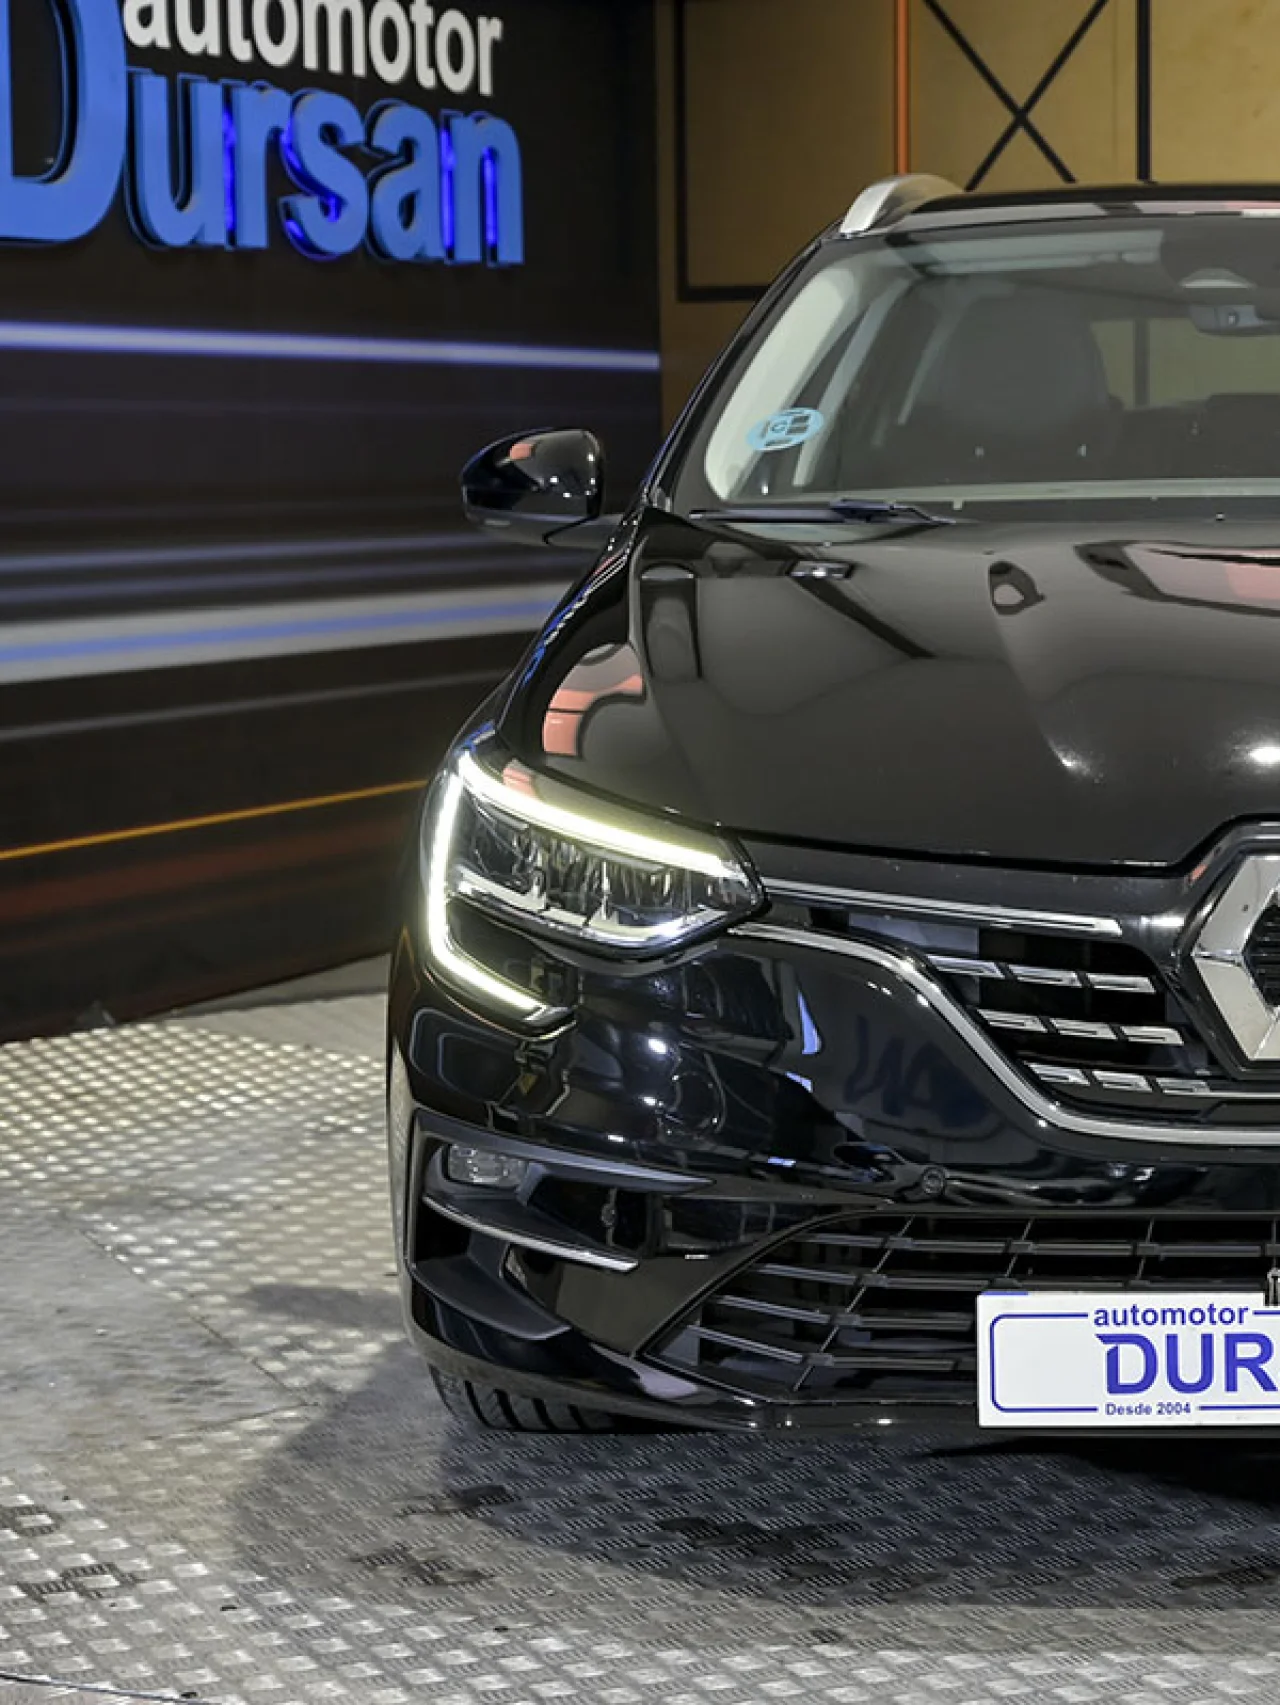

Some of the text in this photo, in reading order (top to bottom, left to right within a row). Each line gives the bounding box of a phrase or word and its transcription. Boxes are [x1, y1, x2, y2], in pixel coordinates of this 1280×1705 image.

[123, 0, 501, 96] automotor
[0, 0, 524, 266] Dursan
[1093, 1303, 1249, 1326] automotor
[1105, 1402, 1191, 1416] Desde 2004
